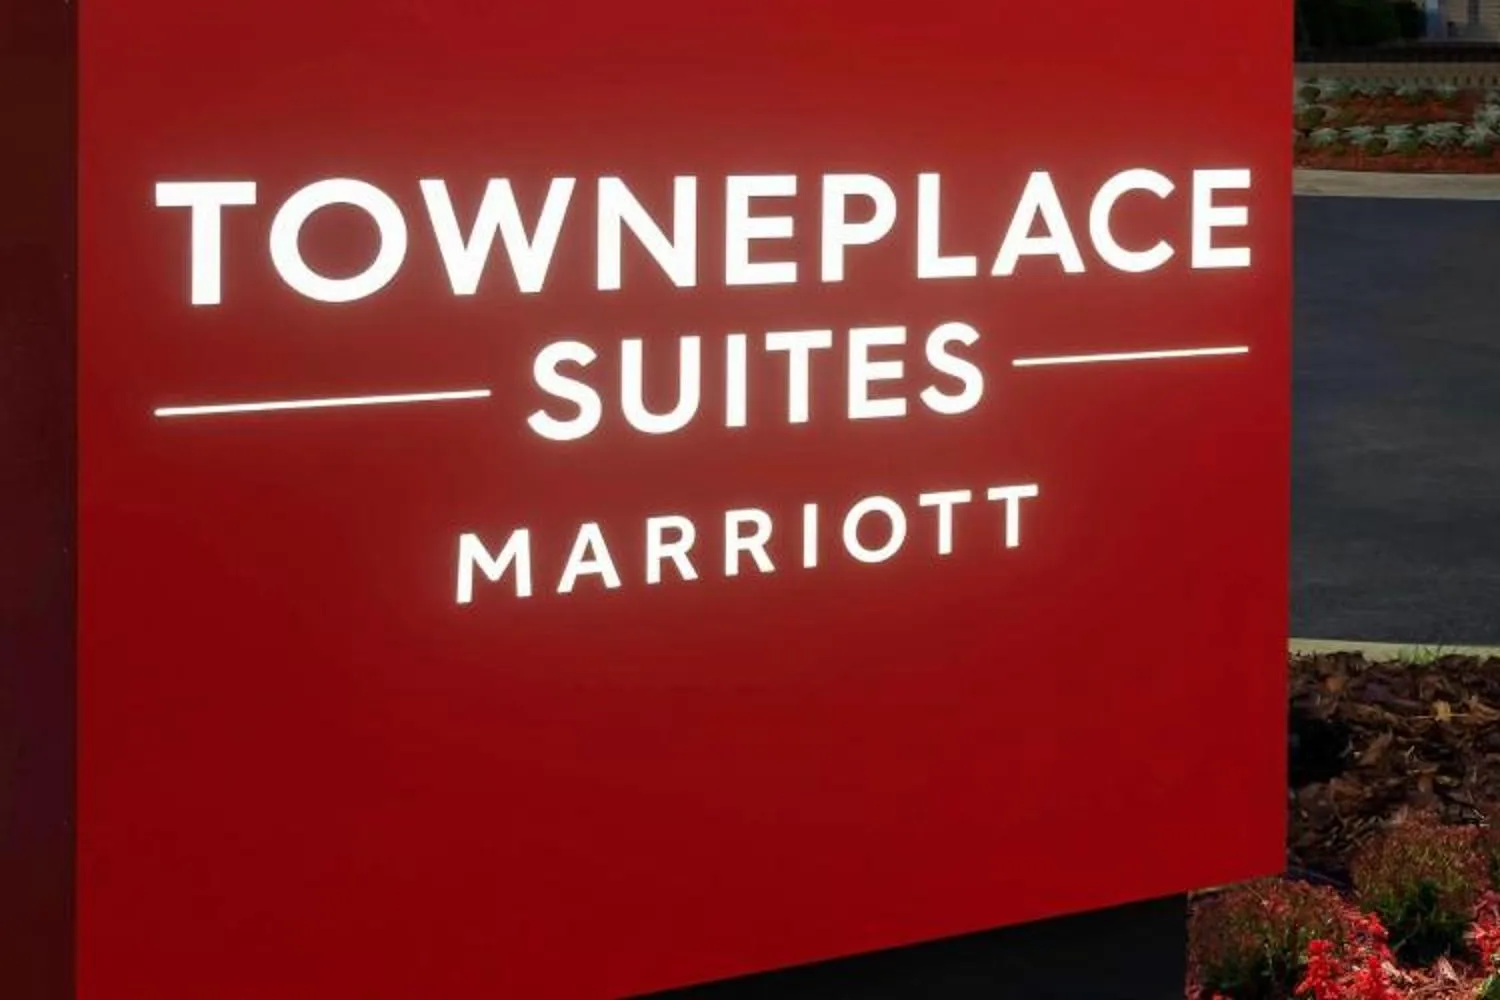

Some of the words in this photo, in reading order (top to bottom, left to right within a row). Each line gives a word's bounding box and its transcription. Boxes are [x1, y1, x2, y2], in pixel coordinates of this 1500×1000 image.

[154, 166, 1252, 307] TOWNEPLACE
[526, 319, 986, 442] SUITES
[455, 482, 1040, 605] MARRIOTT
